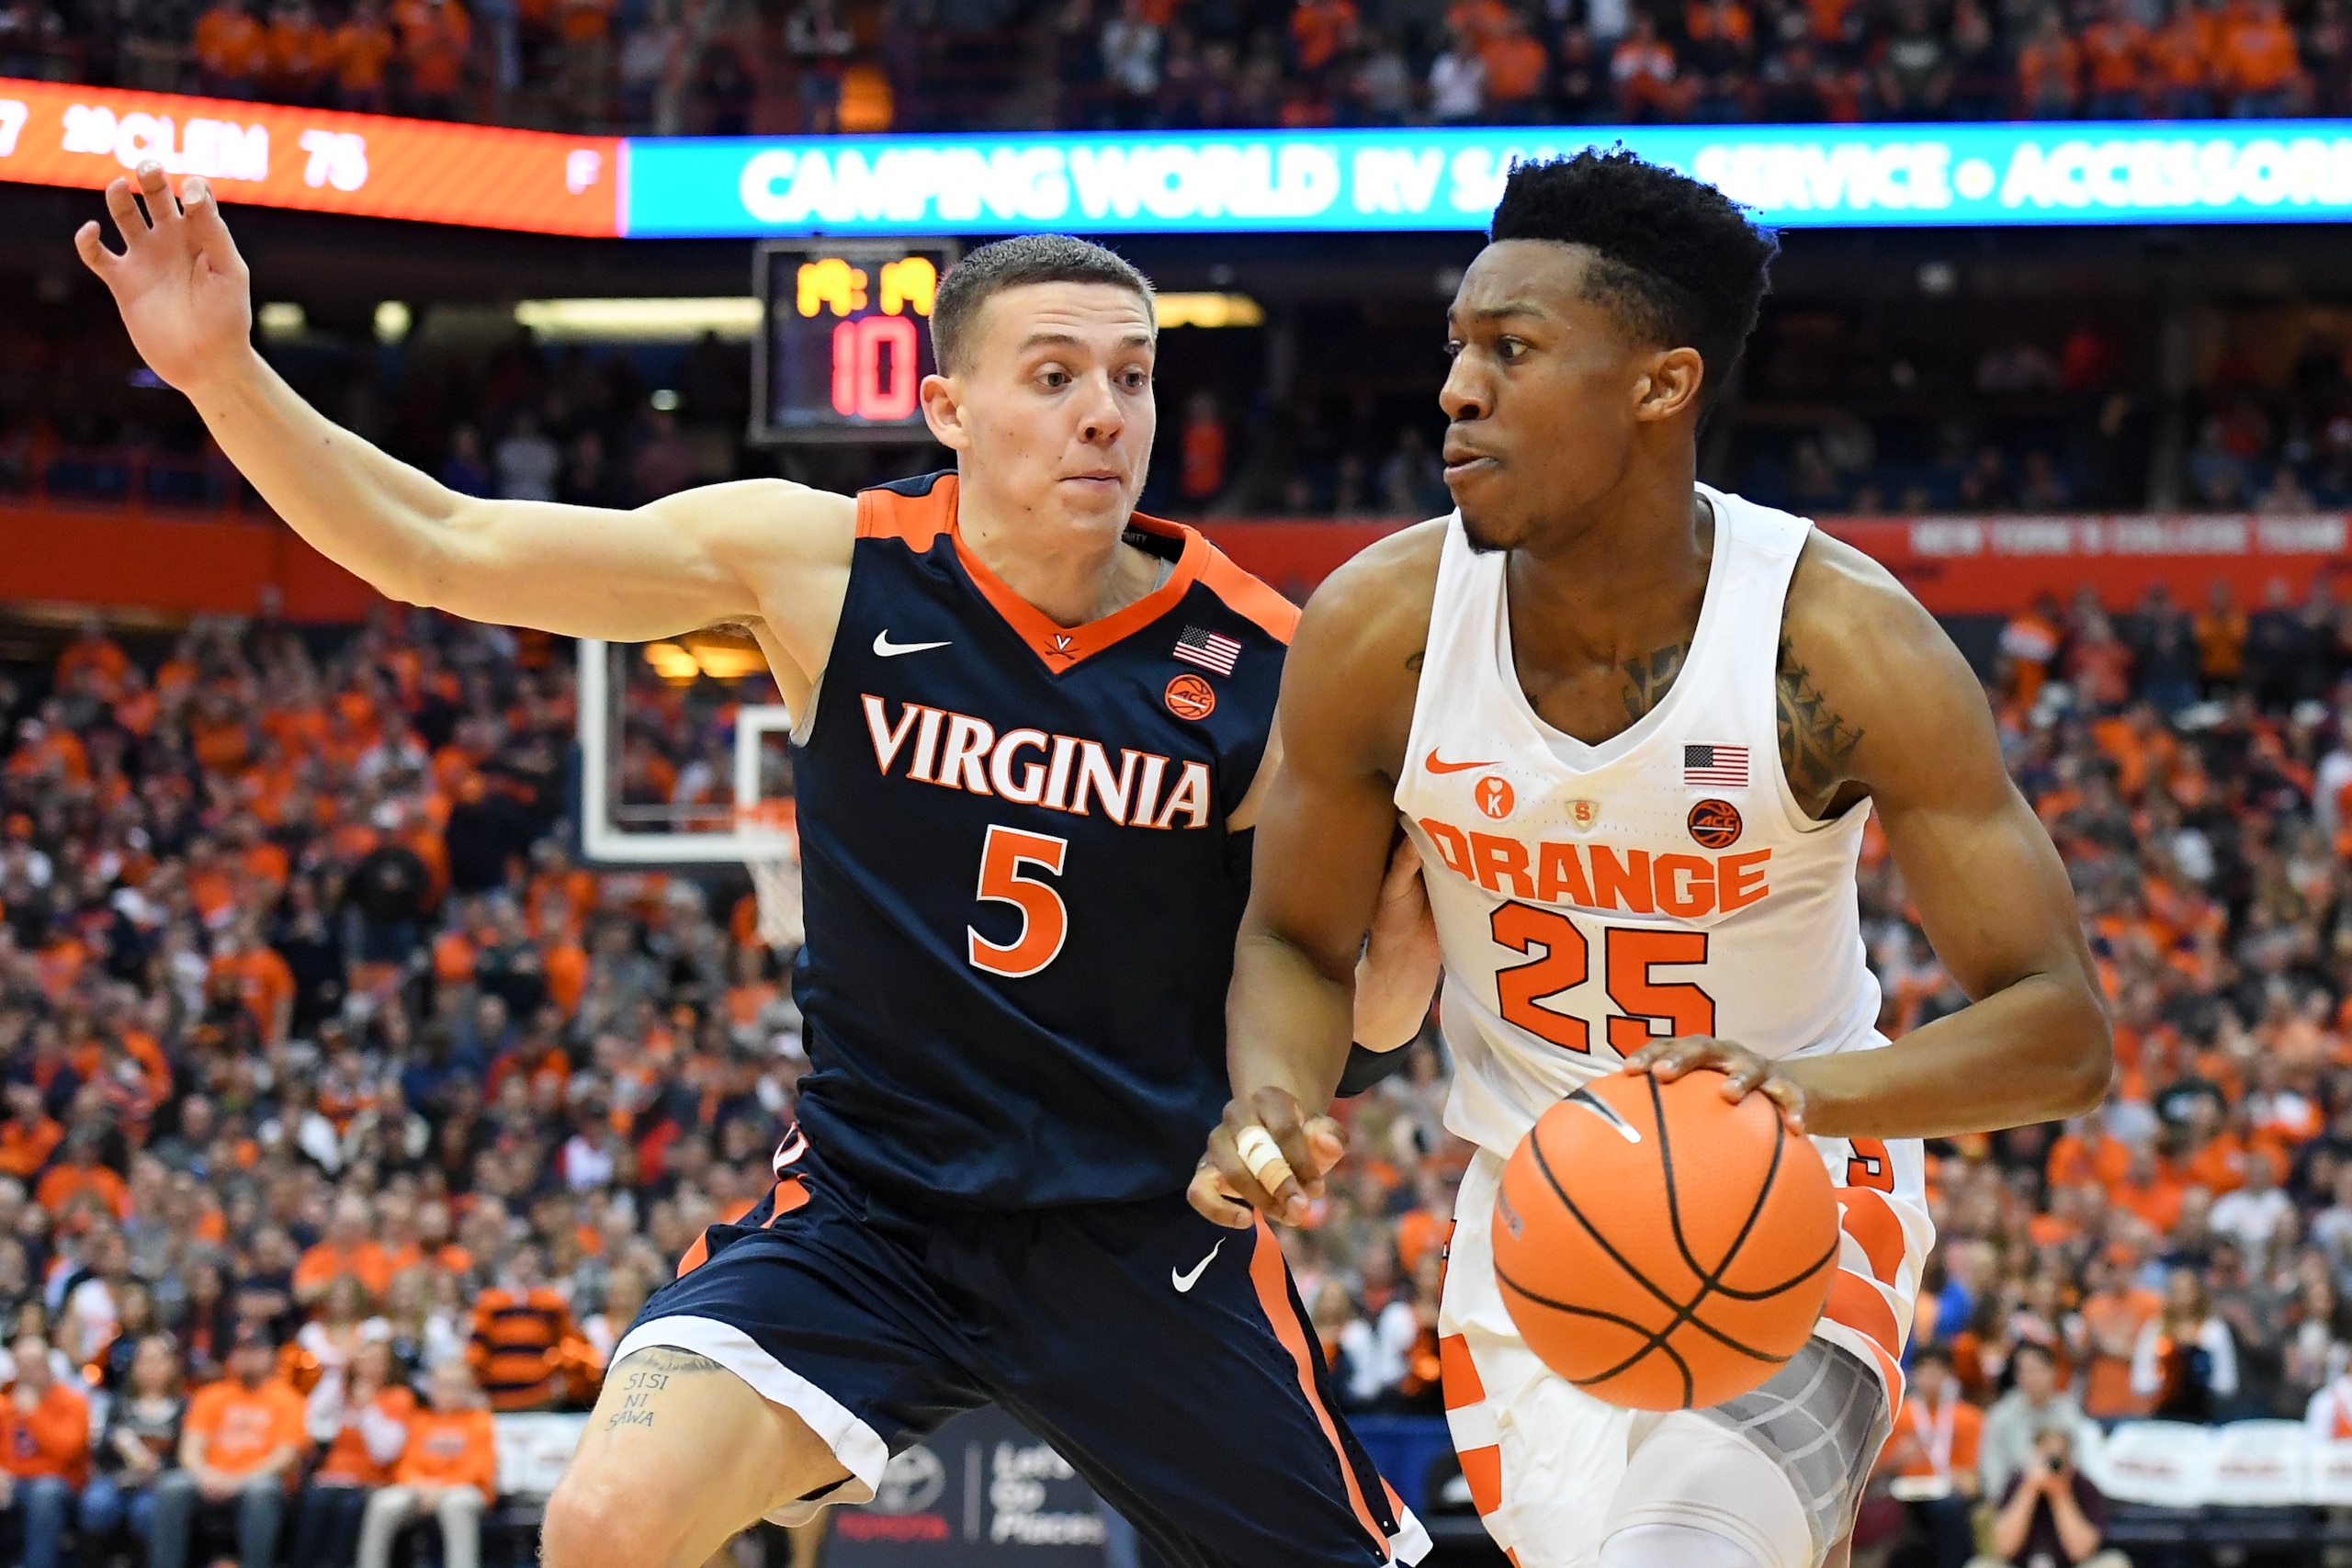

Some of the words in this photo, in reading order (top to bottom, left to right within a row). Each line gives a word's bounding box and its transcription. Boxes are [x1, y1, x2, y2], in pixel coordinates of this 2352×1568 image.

[566, 149, 604, 195] F
[739, 147, 1069, 222] CAMPING
[1067, 143, 1340, 219] WORLD
[1352, 146, 1446, 214] RV
[1692, 141, 1953, 209] SERVICE
[831, 315, 917, 421] 10
[1053, 634, 1073, 651] V
[861, 694, 1211, 829] VIRGINIA
[1487, 793, 1502, 817] K
[1575, 802, 1590, 820] S
[1697, 815, 1737, 827] ACC
[1419, 817, 1771, 918] ORANGE
[967, 824, 1069, 978] 5
[1489, 899, 1716, 1060] 25
[605, 1411, 654, 1431] SAWA
[625, 1393, 649, 1408] NI
